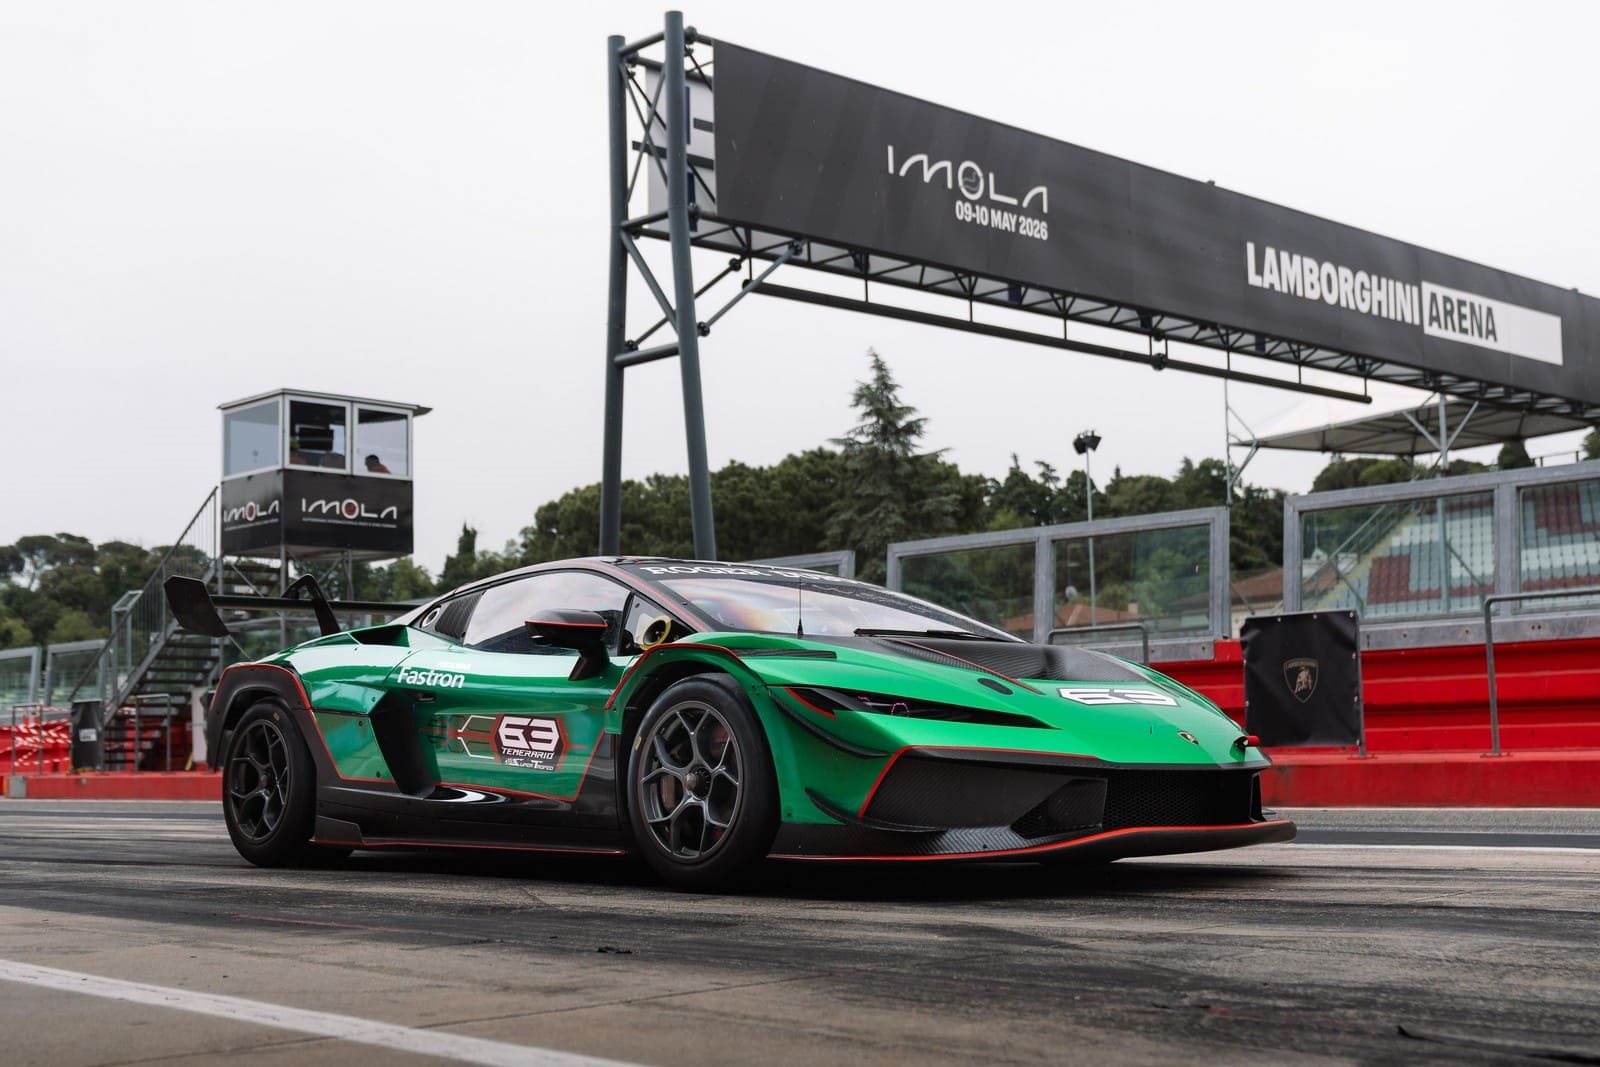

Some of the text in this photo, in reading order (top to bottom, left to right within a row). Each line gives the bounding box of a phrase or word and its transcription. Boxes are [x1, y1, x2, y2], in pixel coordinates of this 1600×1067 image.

[887, 145, 1048, 214] IMOLA
[955, 200, 1048, 240] 09-10 MAY 2026
[1246, 241, 1498, 342] LAMBORGHINI ARENA
[223, 500, 279, 523] IMOLA
[302, 498, 397, 519] IMOLA
[397, 666, 465, 688] Fastron
[1057, 687, 1180, 707] 63
[499, 716, 560, 752] 63
[501, 746, 555, 760] TEMERARIO
